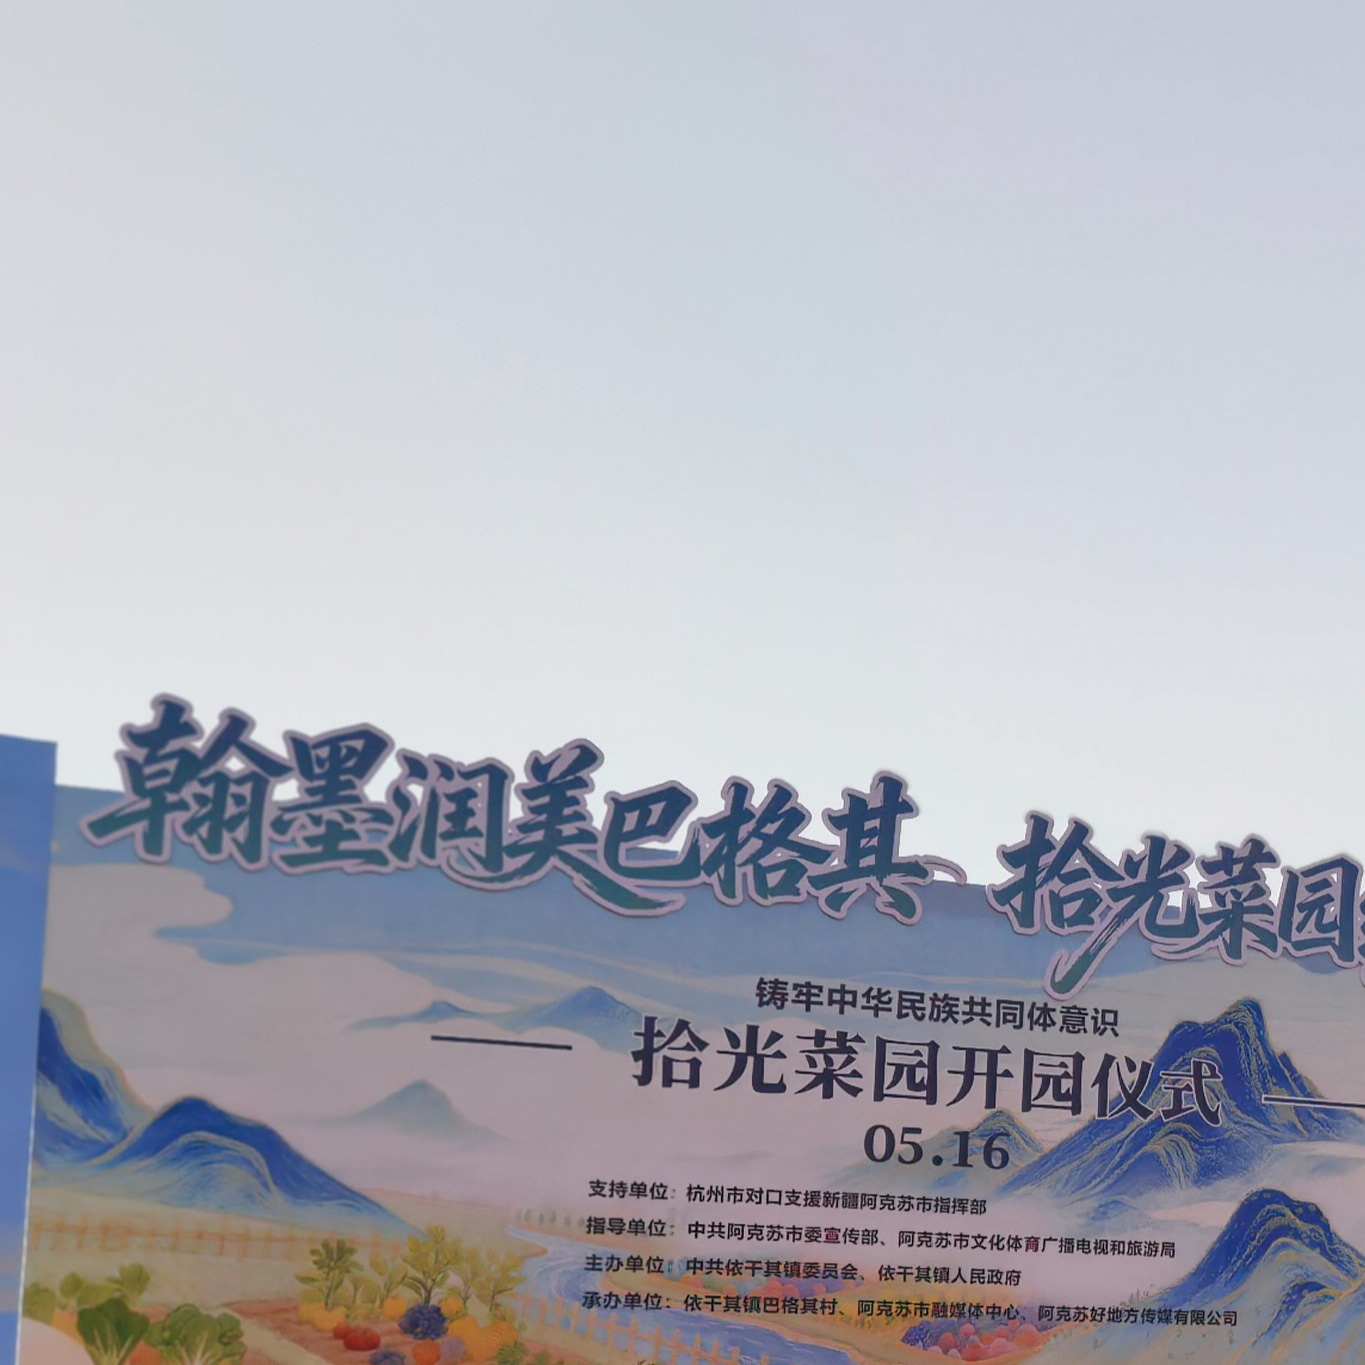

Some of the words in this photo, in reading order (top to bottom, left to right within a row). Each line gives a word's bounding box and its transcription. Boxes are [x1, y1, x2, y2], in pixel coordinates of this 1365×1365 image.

[88, 697, 930, 920] 翰墨润美巴格其
[755, 977, 1120, 1037] 铸牢中华民族共同体意识
[632, 1015, 1223, 1124] 拾光菜园开园仪式
[864, 1123, 1010, 1170] 05.16
